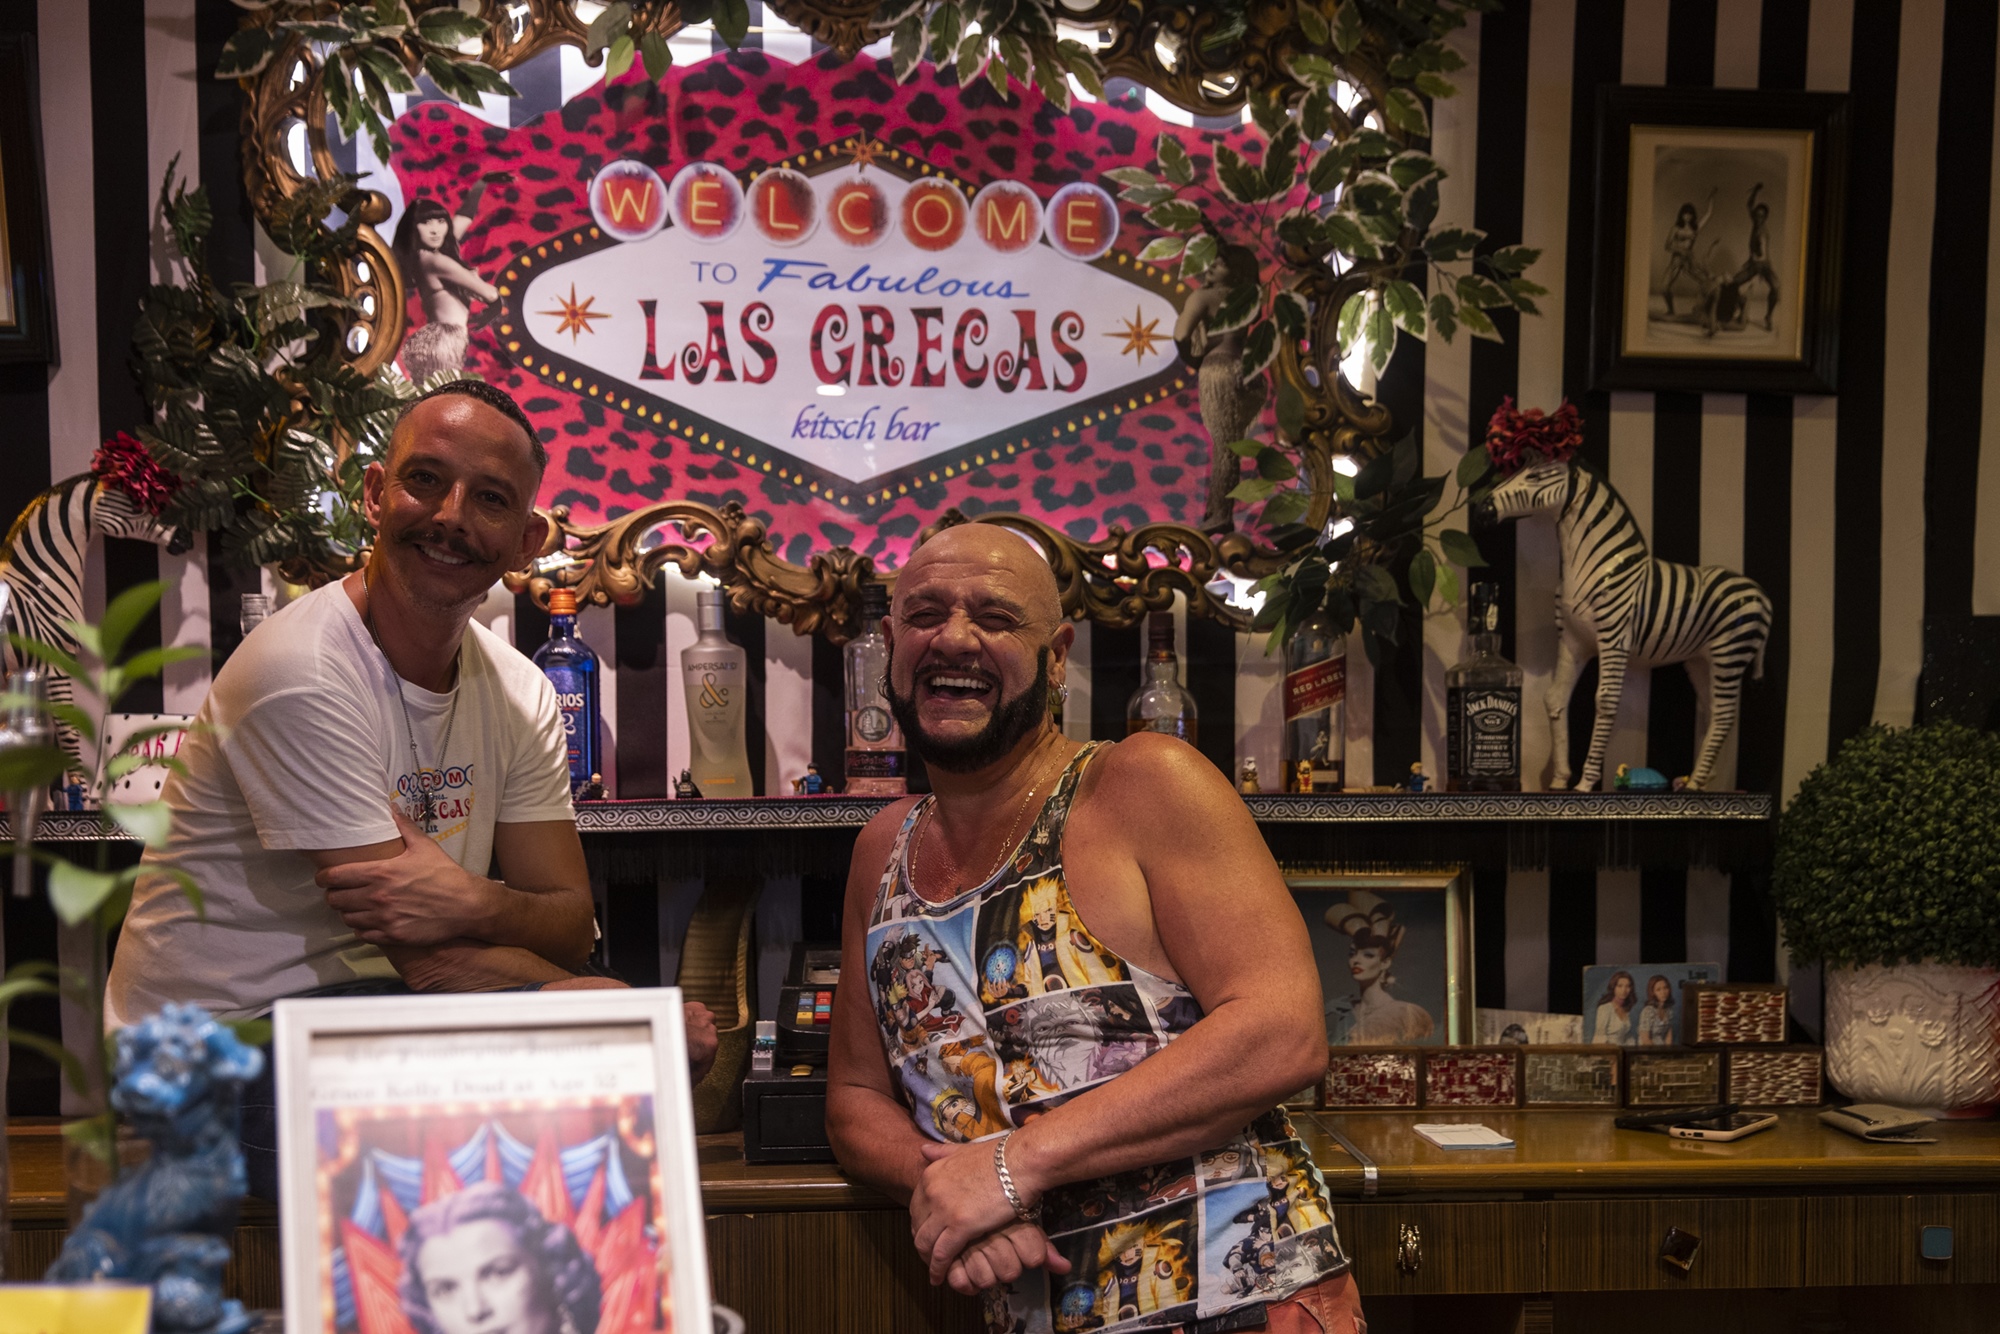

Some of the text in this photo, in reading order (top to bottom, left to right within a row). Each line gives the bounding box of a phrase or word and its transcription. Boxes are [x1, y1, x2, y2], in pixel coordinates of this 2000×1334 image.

[604, 181, 1097, 245] WELCOME
[690, 258, 1030, 298] TO Fabulous
[638, 299, 1088, 394] LAS GRECAS
[790, 403, 941, 442] kitsch bar
[687, 662, 738, 671] AMPERSAND
[1292, 682, 1313, 696] RED
[1314, 670, 1344, 687] LABEL
[1466, 699, 1487, 716] JACK
